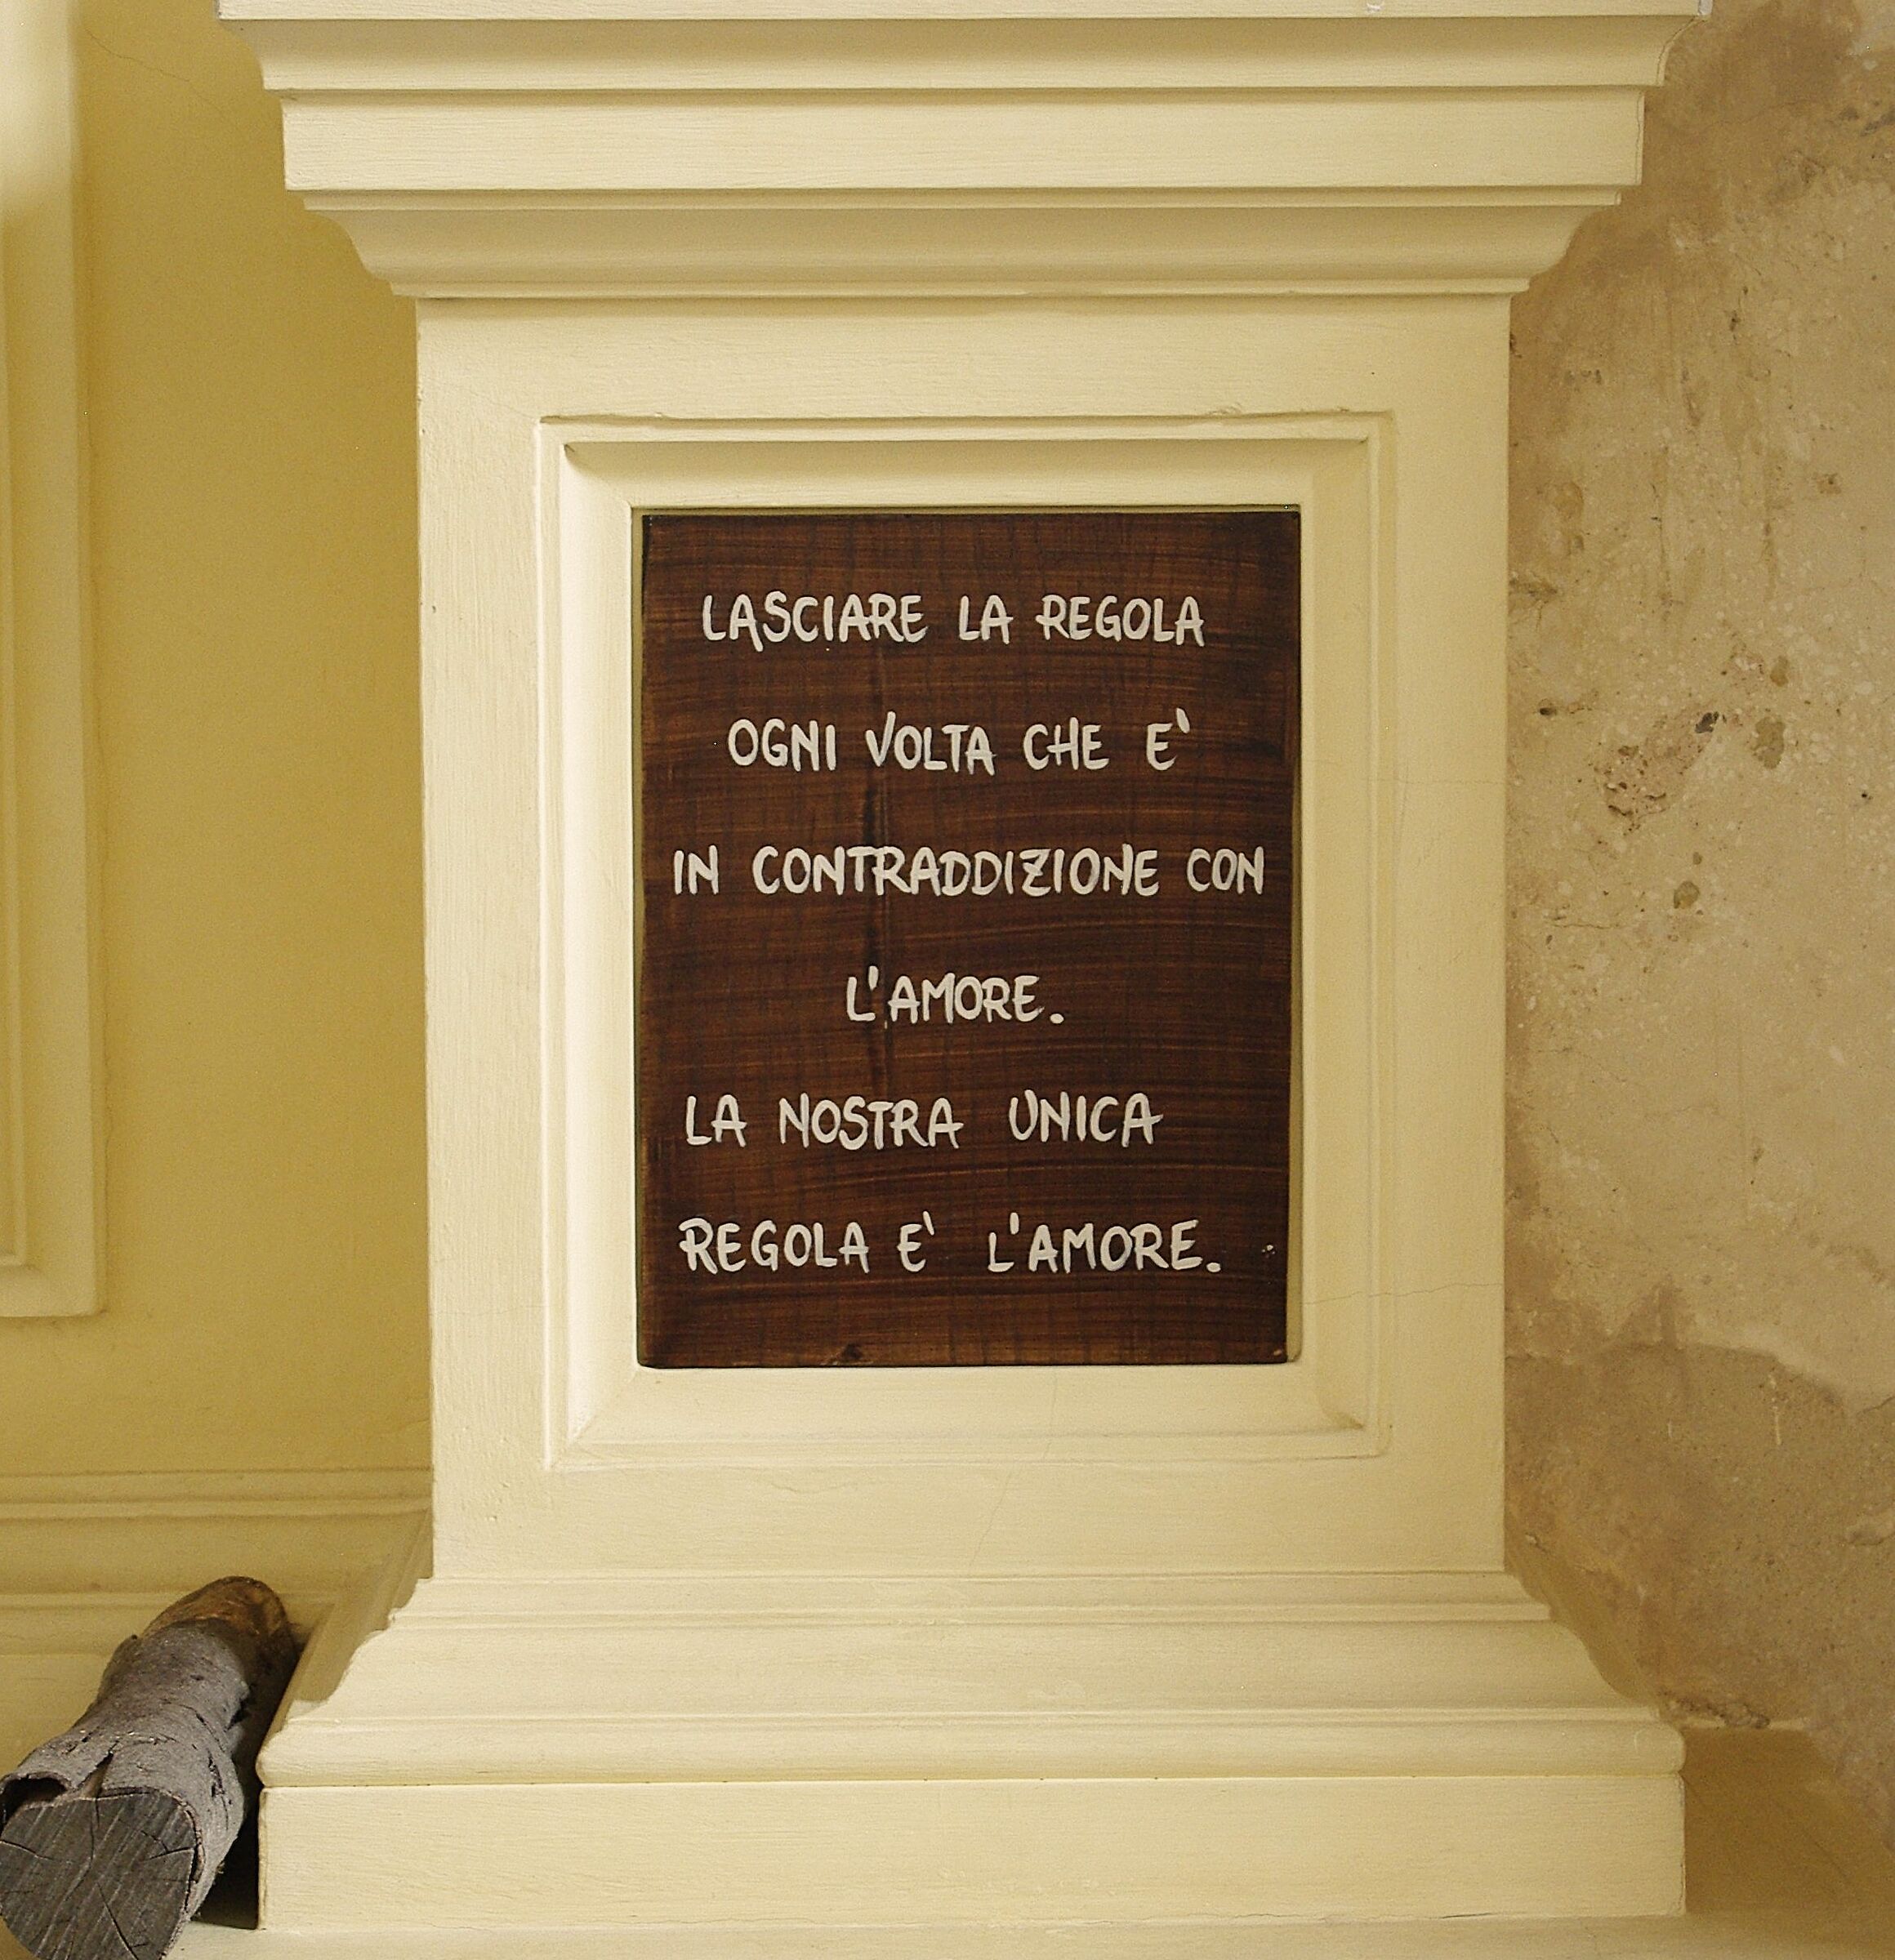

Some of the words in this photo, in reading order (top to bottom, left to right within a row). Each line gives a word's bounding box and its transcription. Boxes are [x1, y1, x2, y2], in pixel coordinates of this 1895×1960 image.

[702, 590, 929, 652] LASCIARE
[958, 595, 1014, 645] LA
[1035, 594, 1205, 647] REGOLA
[727, 718, 837, 772] OGNI
[865, 710, 997, 776] VOLTA
[1023, 717, 1109, 770] CHE
[673, 844, 719, 895] IN
[751, 844, 1160, 897] CONTRADDIZIONE
[1187, 845, 1264, 894] CON
[845, 965, 1065, 1024] L'AMORE.
[684, 1094, 747, 1147] LA
[778, 1093, 964, 1150] NOSTRA
[1008, 1089, 1163, 1147] UNICA
[678, 1217, 870, 1275] REGOLA
[988, 1212, 1221, 1274] L'AMORE.
